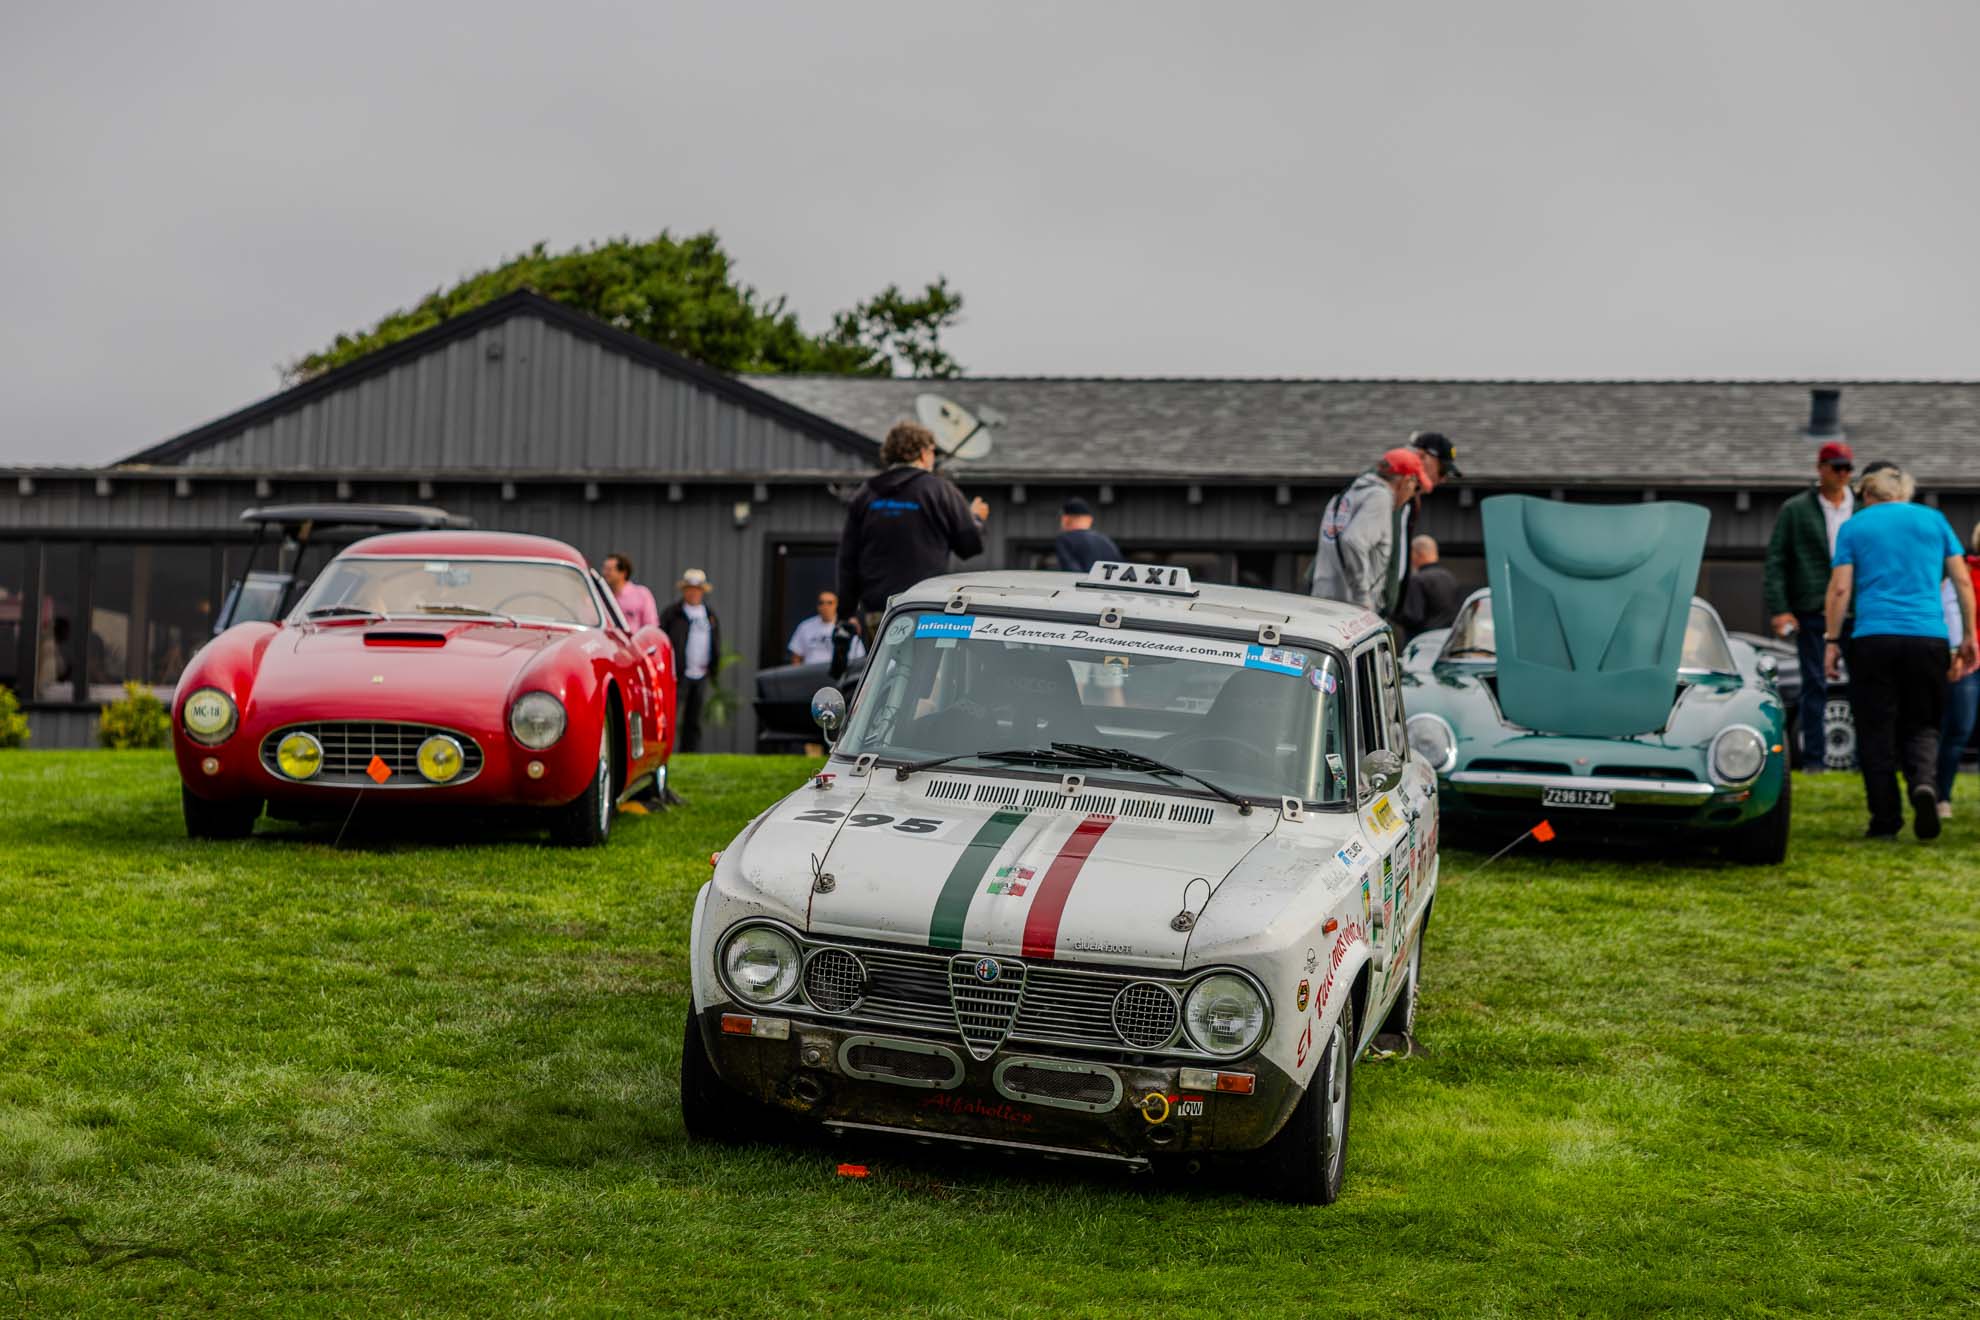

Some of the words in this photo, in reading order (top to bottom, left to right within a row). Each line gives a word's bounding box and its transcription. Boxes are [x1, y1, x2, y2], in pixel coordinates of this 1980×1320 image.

[1102, 563, 1178, 586] TAXI
[917, 622, 972, 632] infinitum
[976, 623, 999, 634] La
[1003, 625, 1067, 640] Carrera
[793, 809, 945, 833] 295
